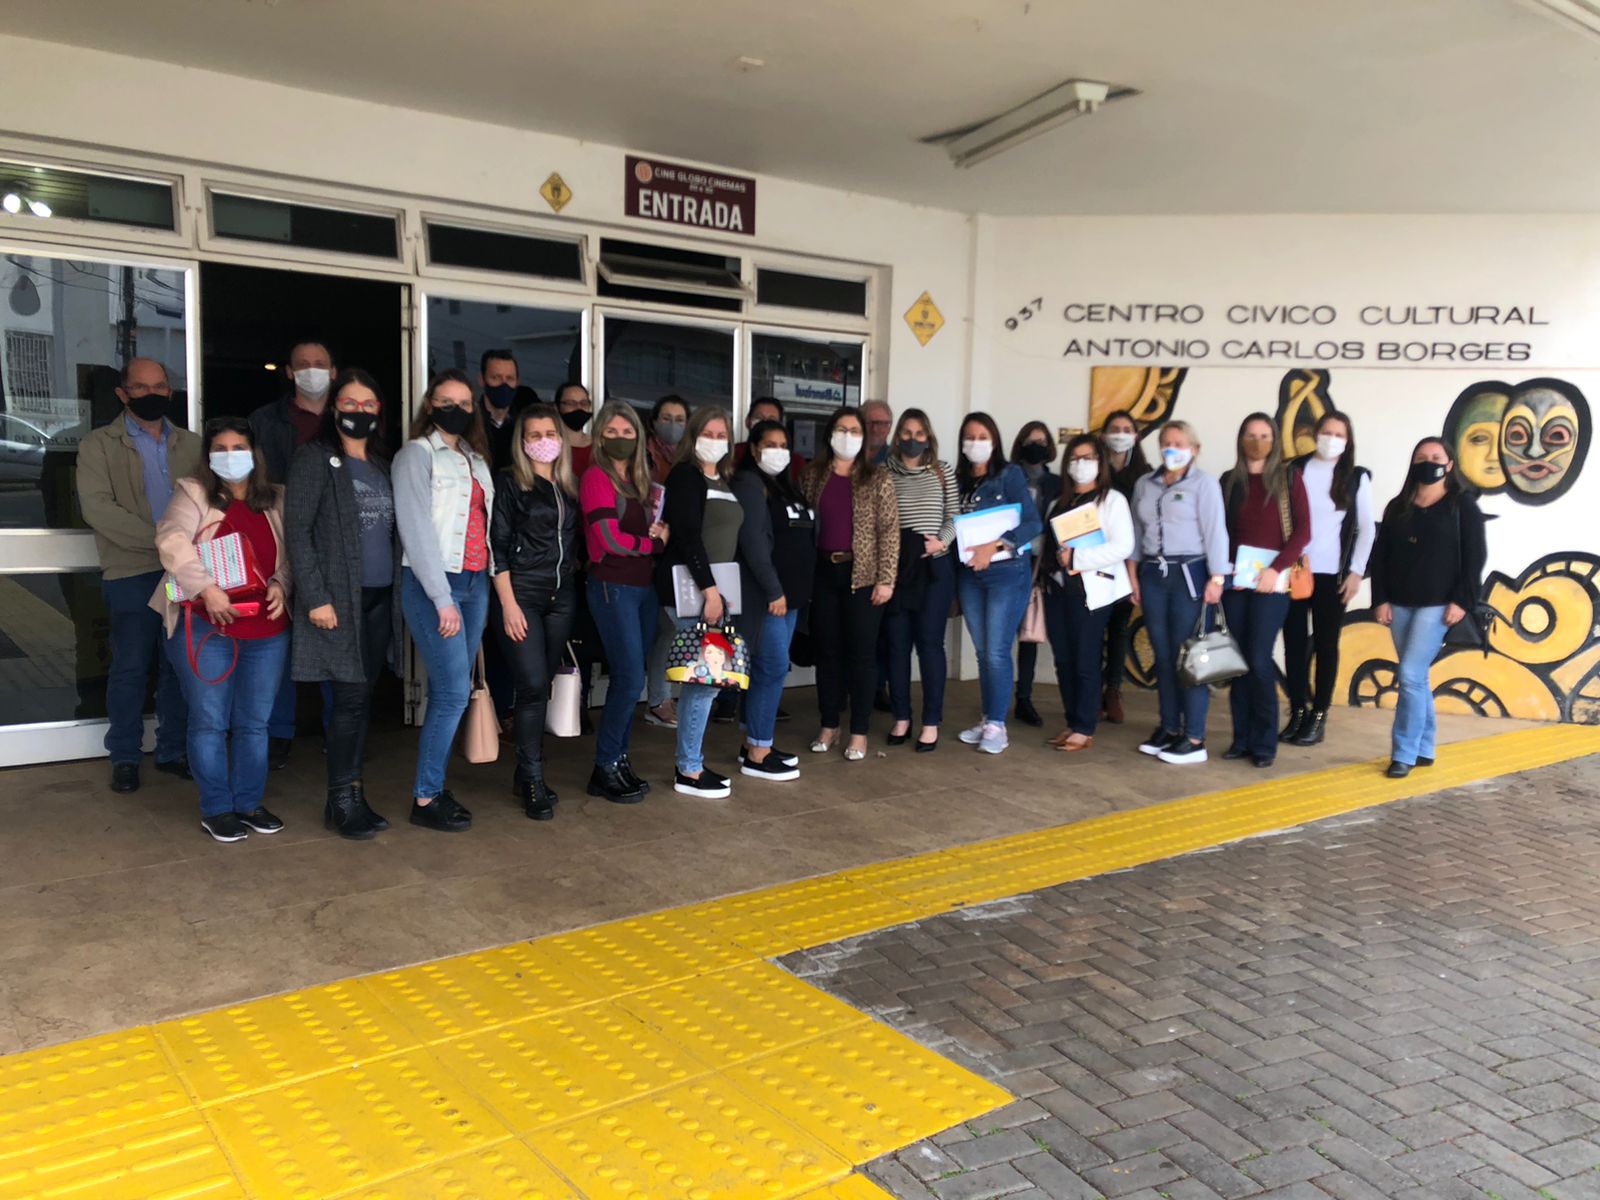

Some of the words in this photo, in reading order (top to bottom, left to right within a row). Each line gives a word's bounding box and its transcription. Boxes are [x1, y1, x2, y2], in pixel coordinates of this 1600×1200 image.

[654, 166, 676, 180] CINE
[677, 171, 707, 185] GLOBO
[708, 177, 747, 194] CINEMAS
[638, 187, 743, 231] ENTRADA
[1063, 303, 1205, 324] CENTRO
[1226, 304, 1337, 326] CIVICO
[1360, 305, 1550, 326] CULTURAL
[1063, 338, 1211, 359] ANTONIO
[1221, 339, 1365, 361] CARLOS
[1377, 341, 1532, 362] BORGES
